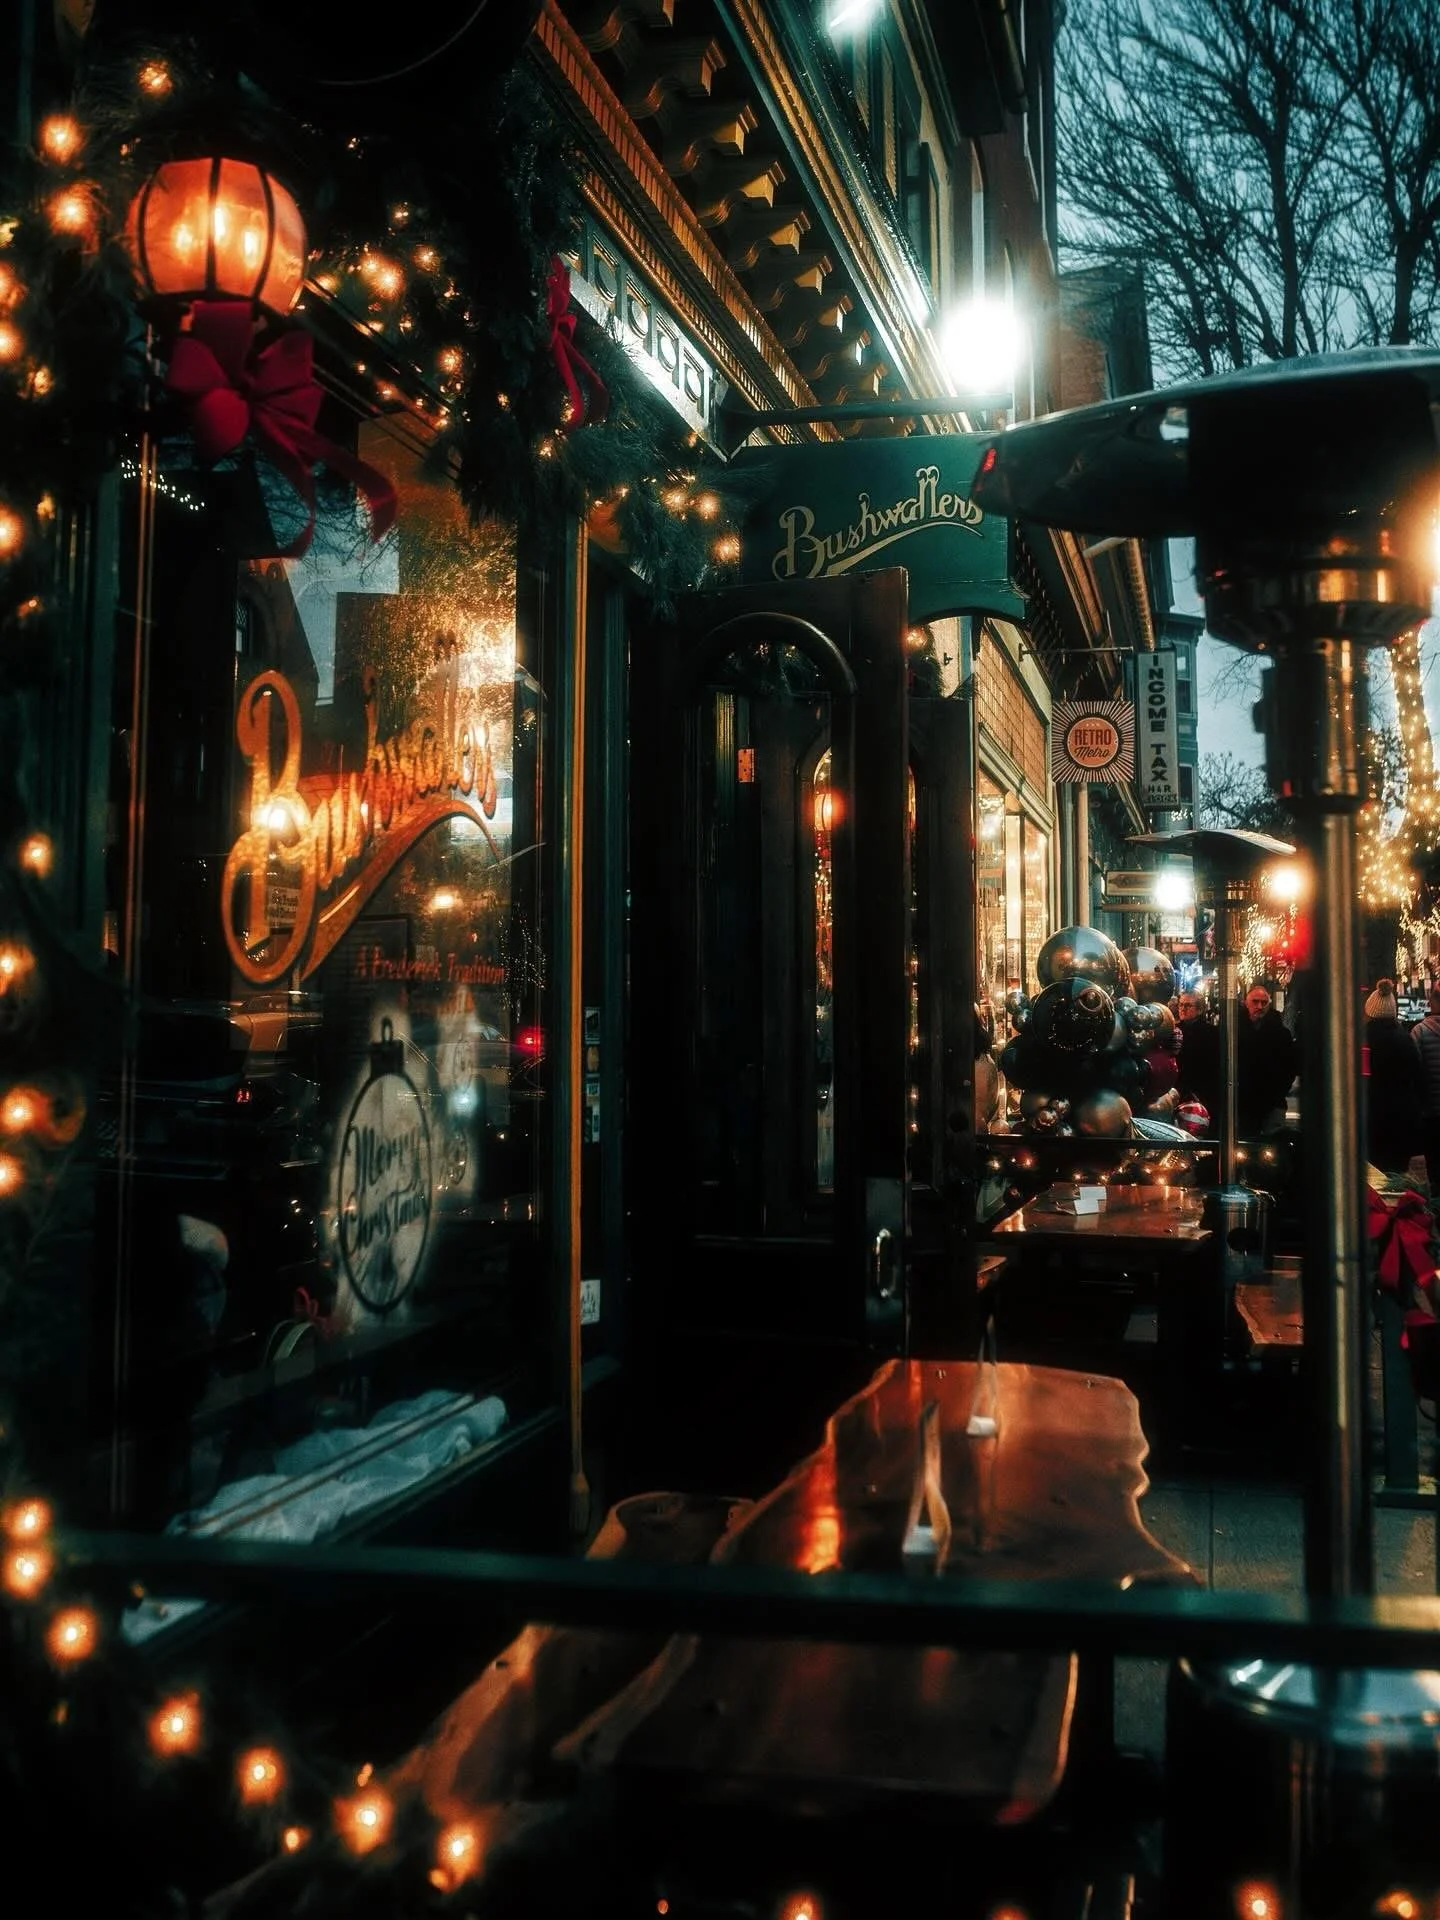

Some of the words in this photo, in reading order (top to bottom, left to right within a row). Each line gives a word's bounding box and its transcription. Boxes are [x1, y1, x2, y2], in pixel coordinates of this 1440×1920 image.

[772, 465, 984, 582] Bushwallers
[1147, 654, 1168, 733] INCOME
[1074, 729, 1112, 746] RETRO
[1074, 746, 1110, 760] Metro
[1149, 743, 1169, 783] TAX
